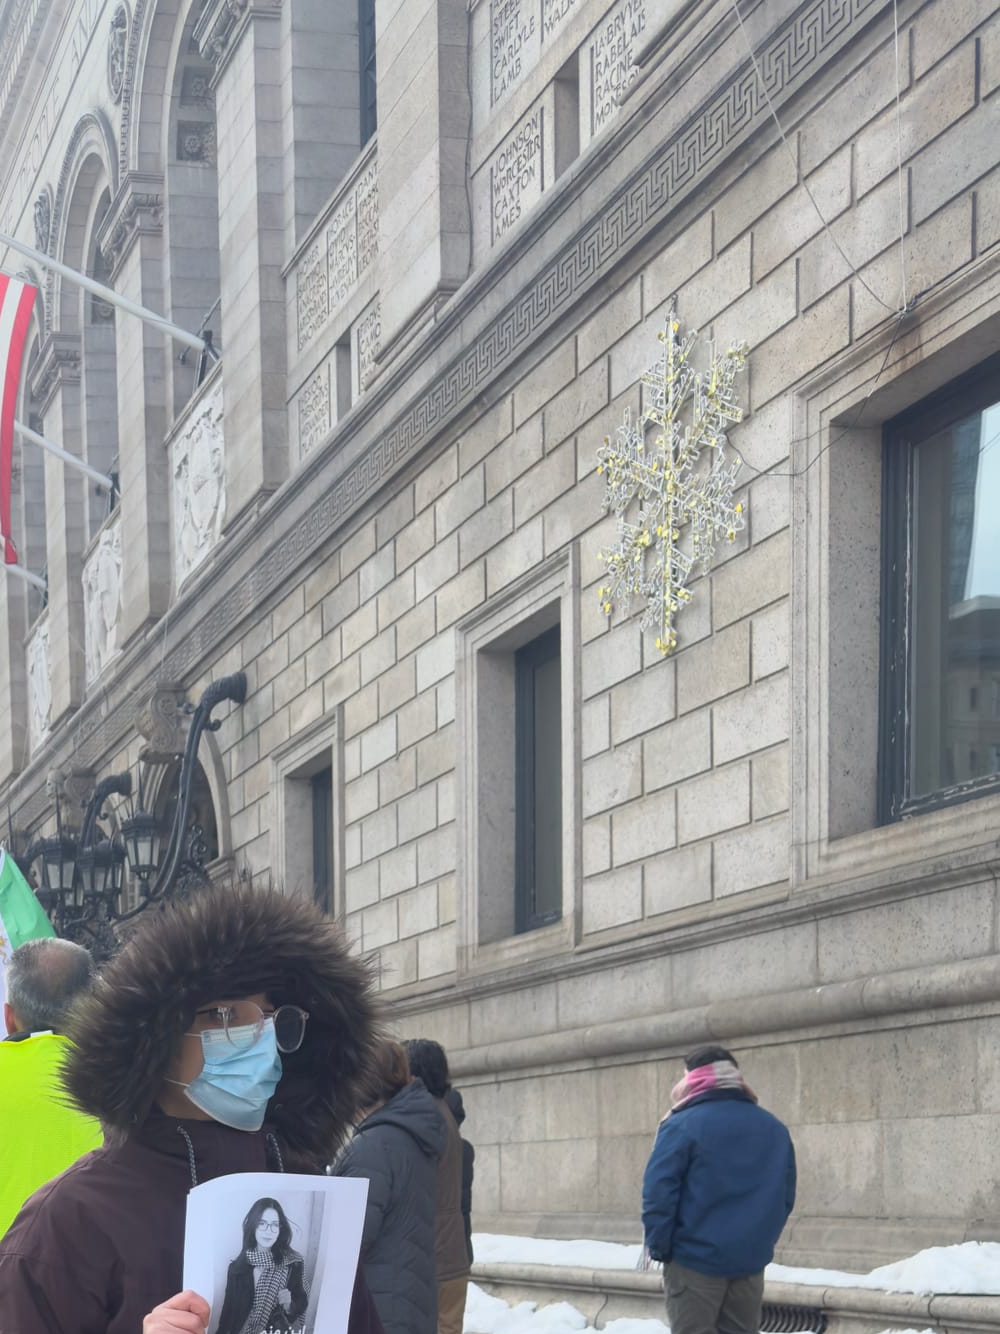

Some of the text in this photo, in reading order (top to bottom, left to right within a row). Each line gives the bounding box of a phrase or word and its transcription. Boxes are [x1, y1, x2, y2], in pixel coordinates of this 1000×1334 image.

[494, 9, 520, 58] SWIFT
[494, 15, 535, 80] CARLYLE
[595, 8, 646, 83] RABELAIS
[494, 57, 521, 104] LAMB
[595, 48, 633, 106] RACINE
[494, 112, 538, 179] JOHNSON
[494, 134, 541, 196] WORCESTER
[494, 159, 535, 219] CAXTON
[495, 199, 522, 240] AMES
